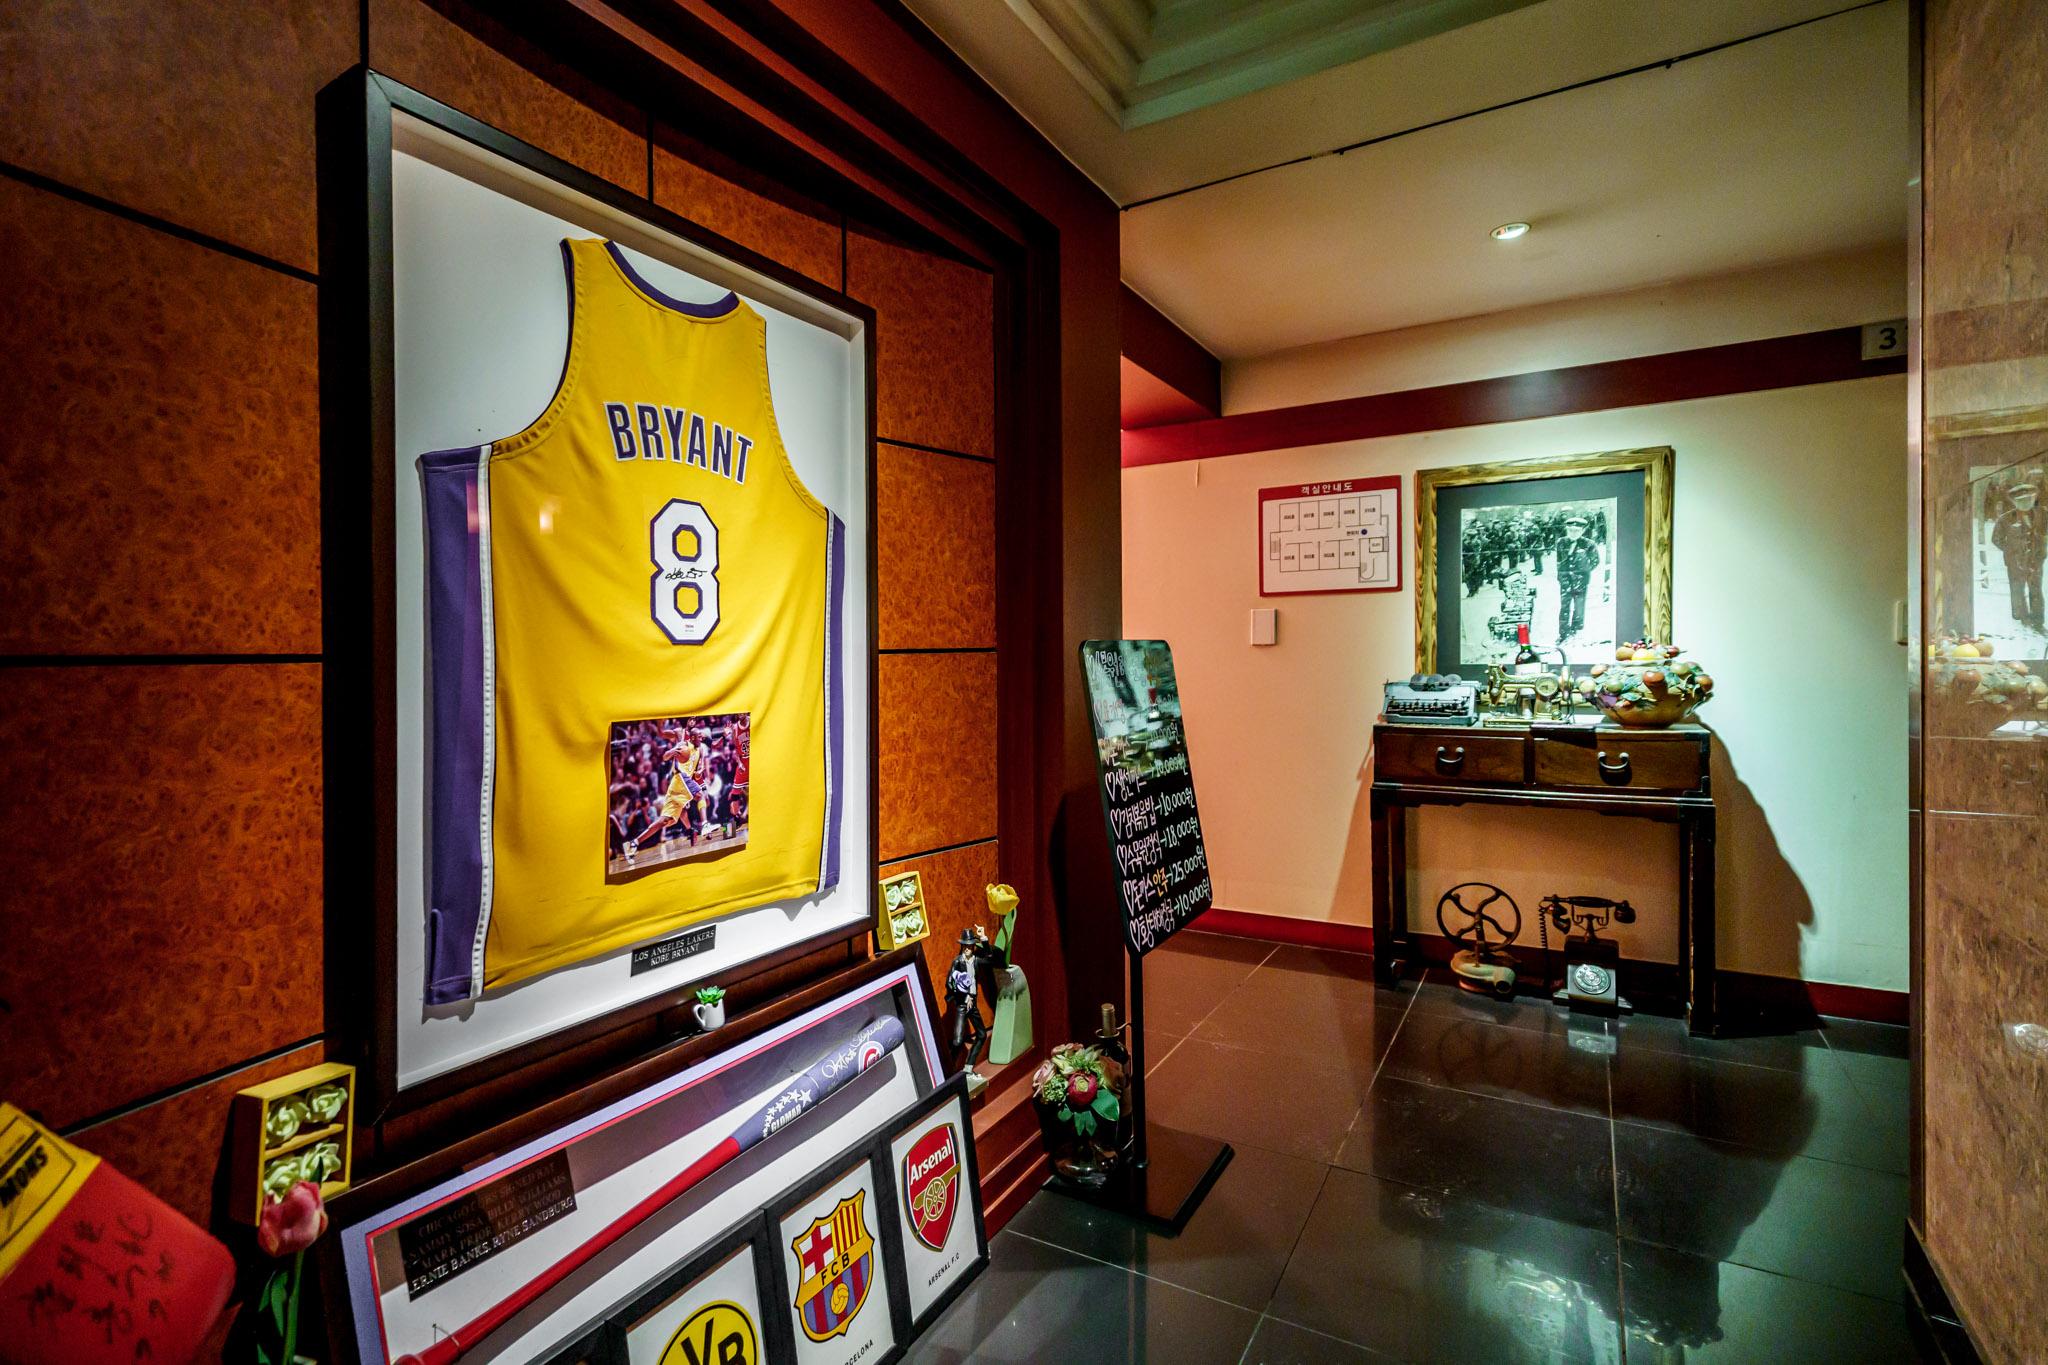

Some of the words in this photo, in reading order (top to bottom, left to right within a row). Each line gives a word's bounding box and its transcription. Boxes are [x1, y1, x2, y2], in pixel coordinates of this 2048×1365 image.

[1879, 327, 1897, 350] 3
[603, 401, 752, 485] BRYANT
[1301, 482, 1353, 494] 객실안내도
[650, 498, 720, 645] 8
[1120, 795, 1157, 839] 김치볶음밥
[1161, 787, 1195, 816] 10,000원
[1166, 816, 1200, 848] 18,000원
[1172, 845, 1206, 883] 25,000원
[1179, 876, 1211, 917] 10,000원
[634, 950, 649, 962] LOS
[651, 939, 685, 958] ANGELES
[687, 930, 715, 945] LAKERS
[650, 954, 670, 967] KOBE
[671, 942, 700, 960] BRYANT
[910, 1138, 952, 1186] Arsenal
[411, 1263, 449, 1291] ERNIE
[492, 1224, 521, 1248] RYNE
[521, 1196, 573, 1232] SANDBURG
[821, 1252, 850, 1286] FCB
[928, 1261, 950, 1287] ARSENAL
